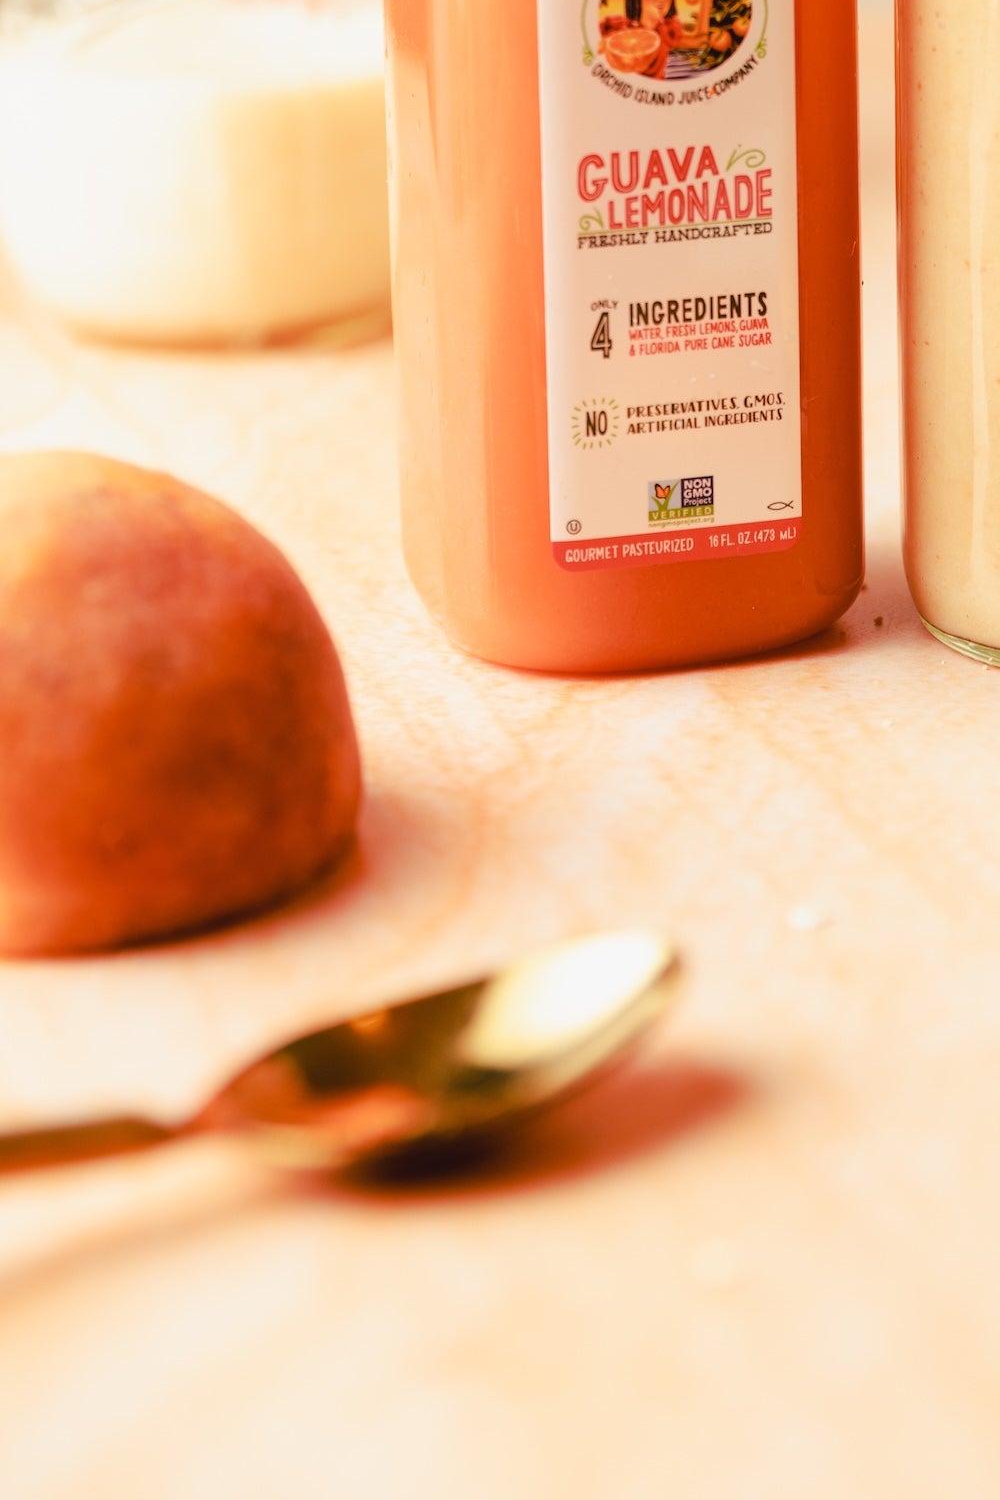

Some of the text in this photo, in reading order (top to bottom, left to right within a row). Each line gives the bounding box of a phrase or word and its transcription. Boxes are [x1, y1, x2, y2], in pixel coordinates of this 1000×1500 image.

[591, 54, 760, 106] ORCHID ISLAND JUICE COMPANY
[577, 145, 719, 203] GUAVA
[608, 168, 773, 230] LEMONADE
[577, 221, 773, 249] FRESHLY HANDCRAFTED
[590, 299, 619, 311] ONLY
[629, 291, 768, 327] INGREDIENTS
[590, 311, 613, 359] 4
[628, 317, 769, 341] WATER, FRESH LEMONS, GUAVA
[628, 332, 773, 357] & FLORIDA PURE CANE SUGAR
[585, 410, 608, 438] NO
[626, 408, 783, 435] ARTIFICIAL INGREDIENTS
[684, 477, 712, 489] NON
[684, 487, 713, 499] GMO
[651, 506, 713, 520] VERIFIED
[684, 497, 713, 506] Project
[565, 545, 618, 564] GOURMET
[622, 537, 695, 558] PASTEURIZED
[708, 534, 719, 548] 16
